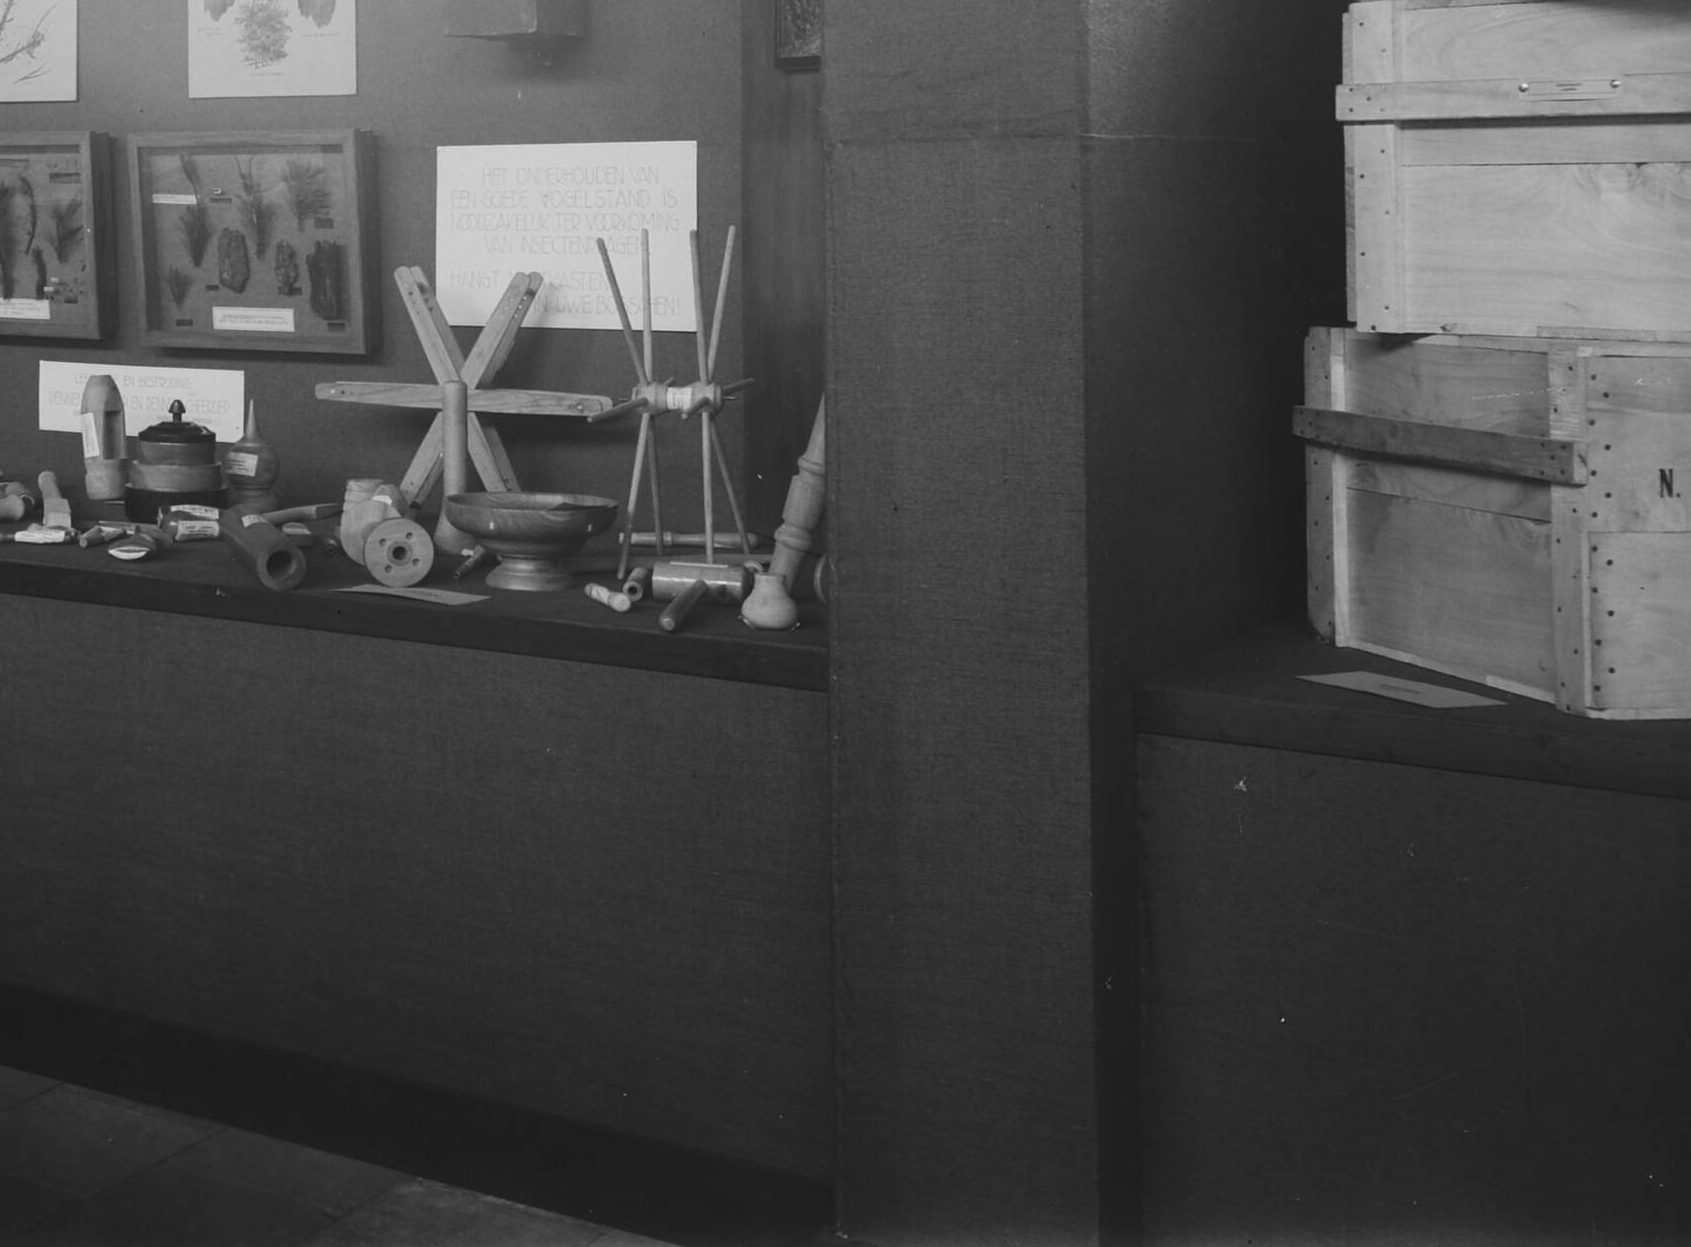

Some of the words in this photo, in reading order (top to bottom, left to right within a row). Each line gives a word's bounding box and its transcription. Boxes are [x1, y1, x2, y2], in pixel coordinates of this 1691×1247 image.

[481, 166, 508, 185] HET
[515, 165, 626, 185] ONDERHOUDEN
[628, 165, 660, 184] VAN
[450, 189, 477, 209] EEN
[482, 189, 530, 209] GOEDE
[539, 189, 651, 209] VOGELSTAND
[661, 188, 679, 208] IS
[555, 213, 581, 232] TER
[584, 211, 681, 232] VOORKOMING
[482, 235, 513, 254] VAN
[450, 270, 500, 290] HANGT
[555, 294, 595, 315] UWE
[1659, 468, 1681, 498] N.
